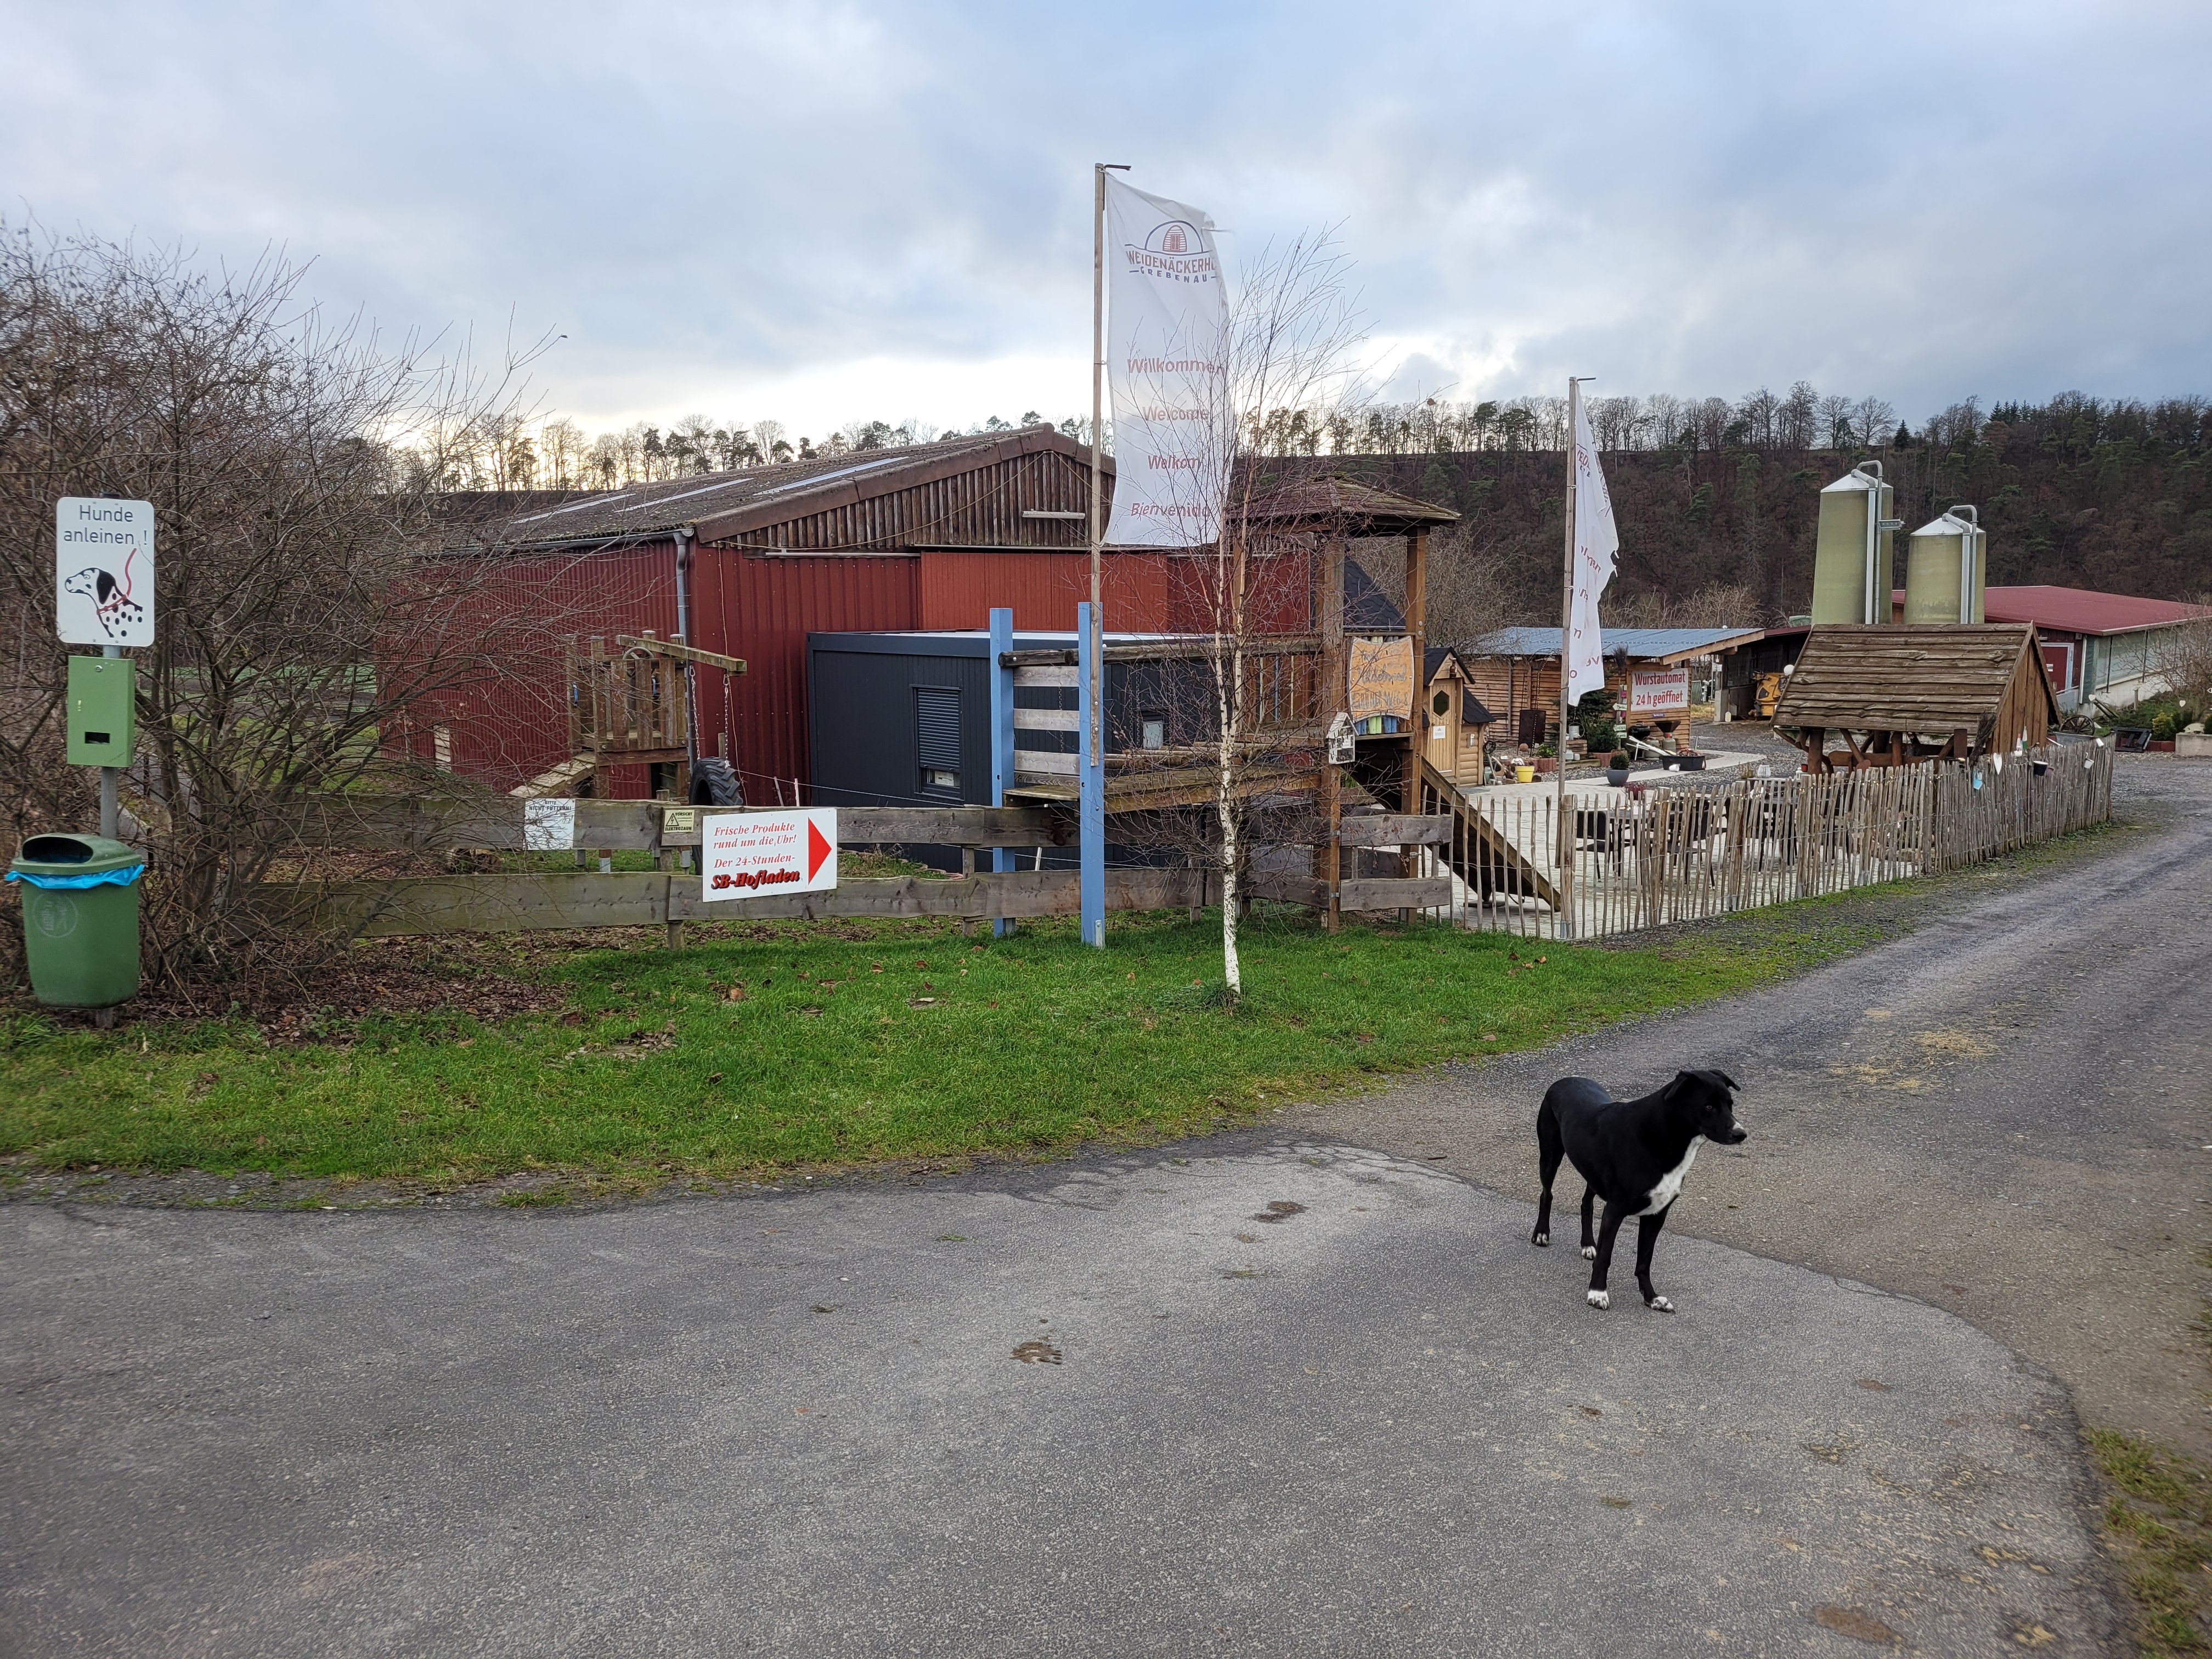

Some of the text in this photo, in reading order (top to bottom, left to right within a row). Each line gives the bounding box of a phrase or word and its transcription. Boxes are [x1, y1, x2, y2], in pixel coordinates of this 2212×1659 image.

[1140, 266, 1207, 283] GREBENAU
[1127, 357, 1226, 376] Willkommen
[1142, 406, 1209, 421] Welcome
[80, 504, 133, 522] Hunde
[1131, 502, 1211, 517] Bienvenido
[64, 527, 134, 545] anleinen
[1634, 671, 1686, 686] Wurstautomat
[1636, 690, 1684, 707] 24 h geöffnet
[714, 822, 795, 837] Frische Produkte
[713, 834, 797, 849] rund um die Uhr!
[714, 853, 795, 868] Der 24-Stunden-
[711, 868, 800, 890] SB-Hofladen
